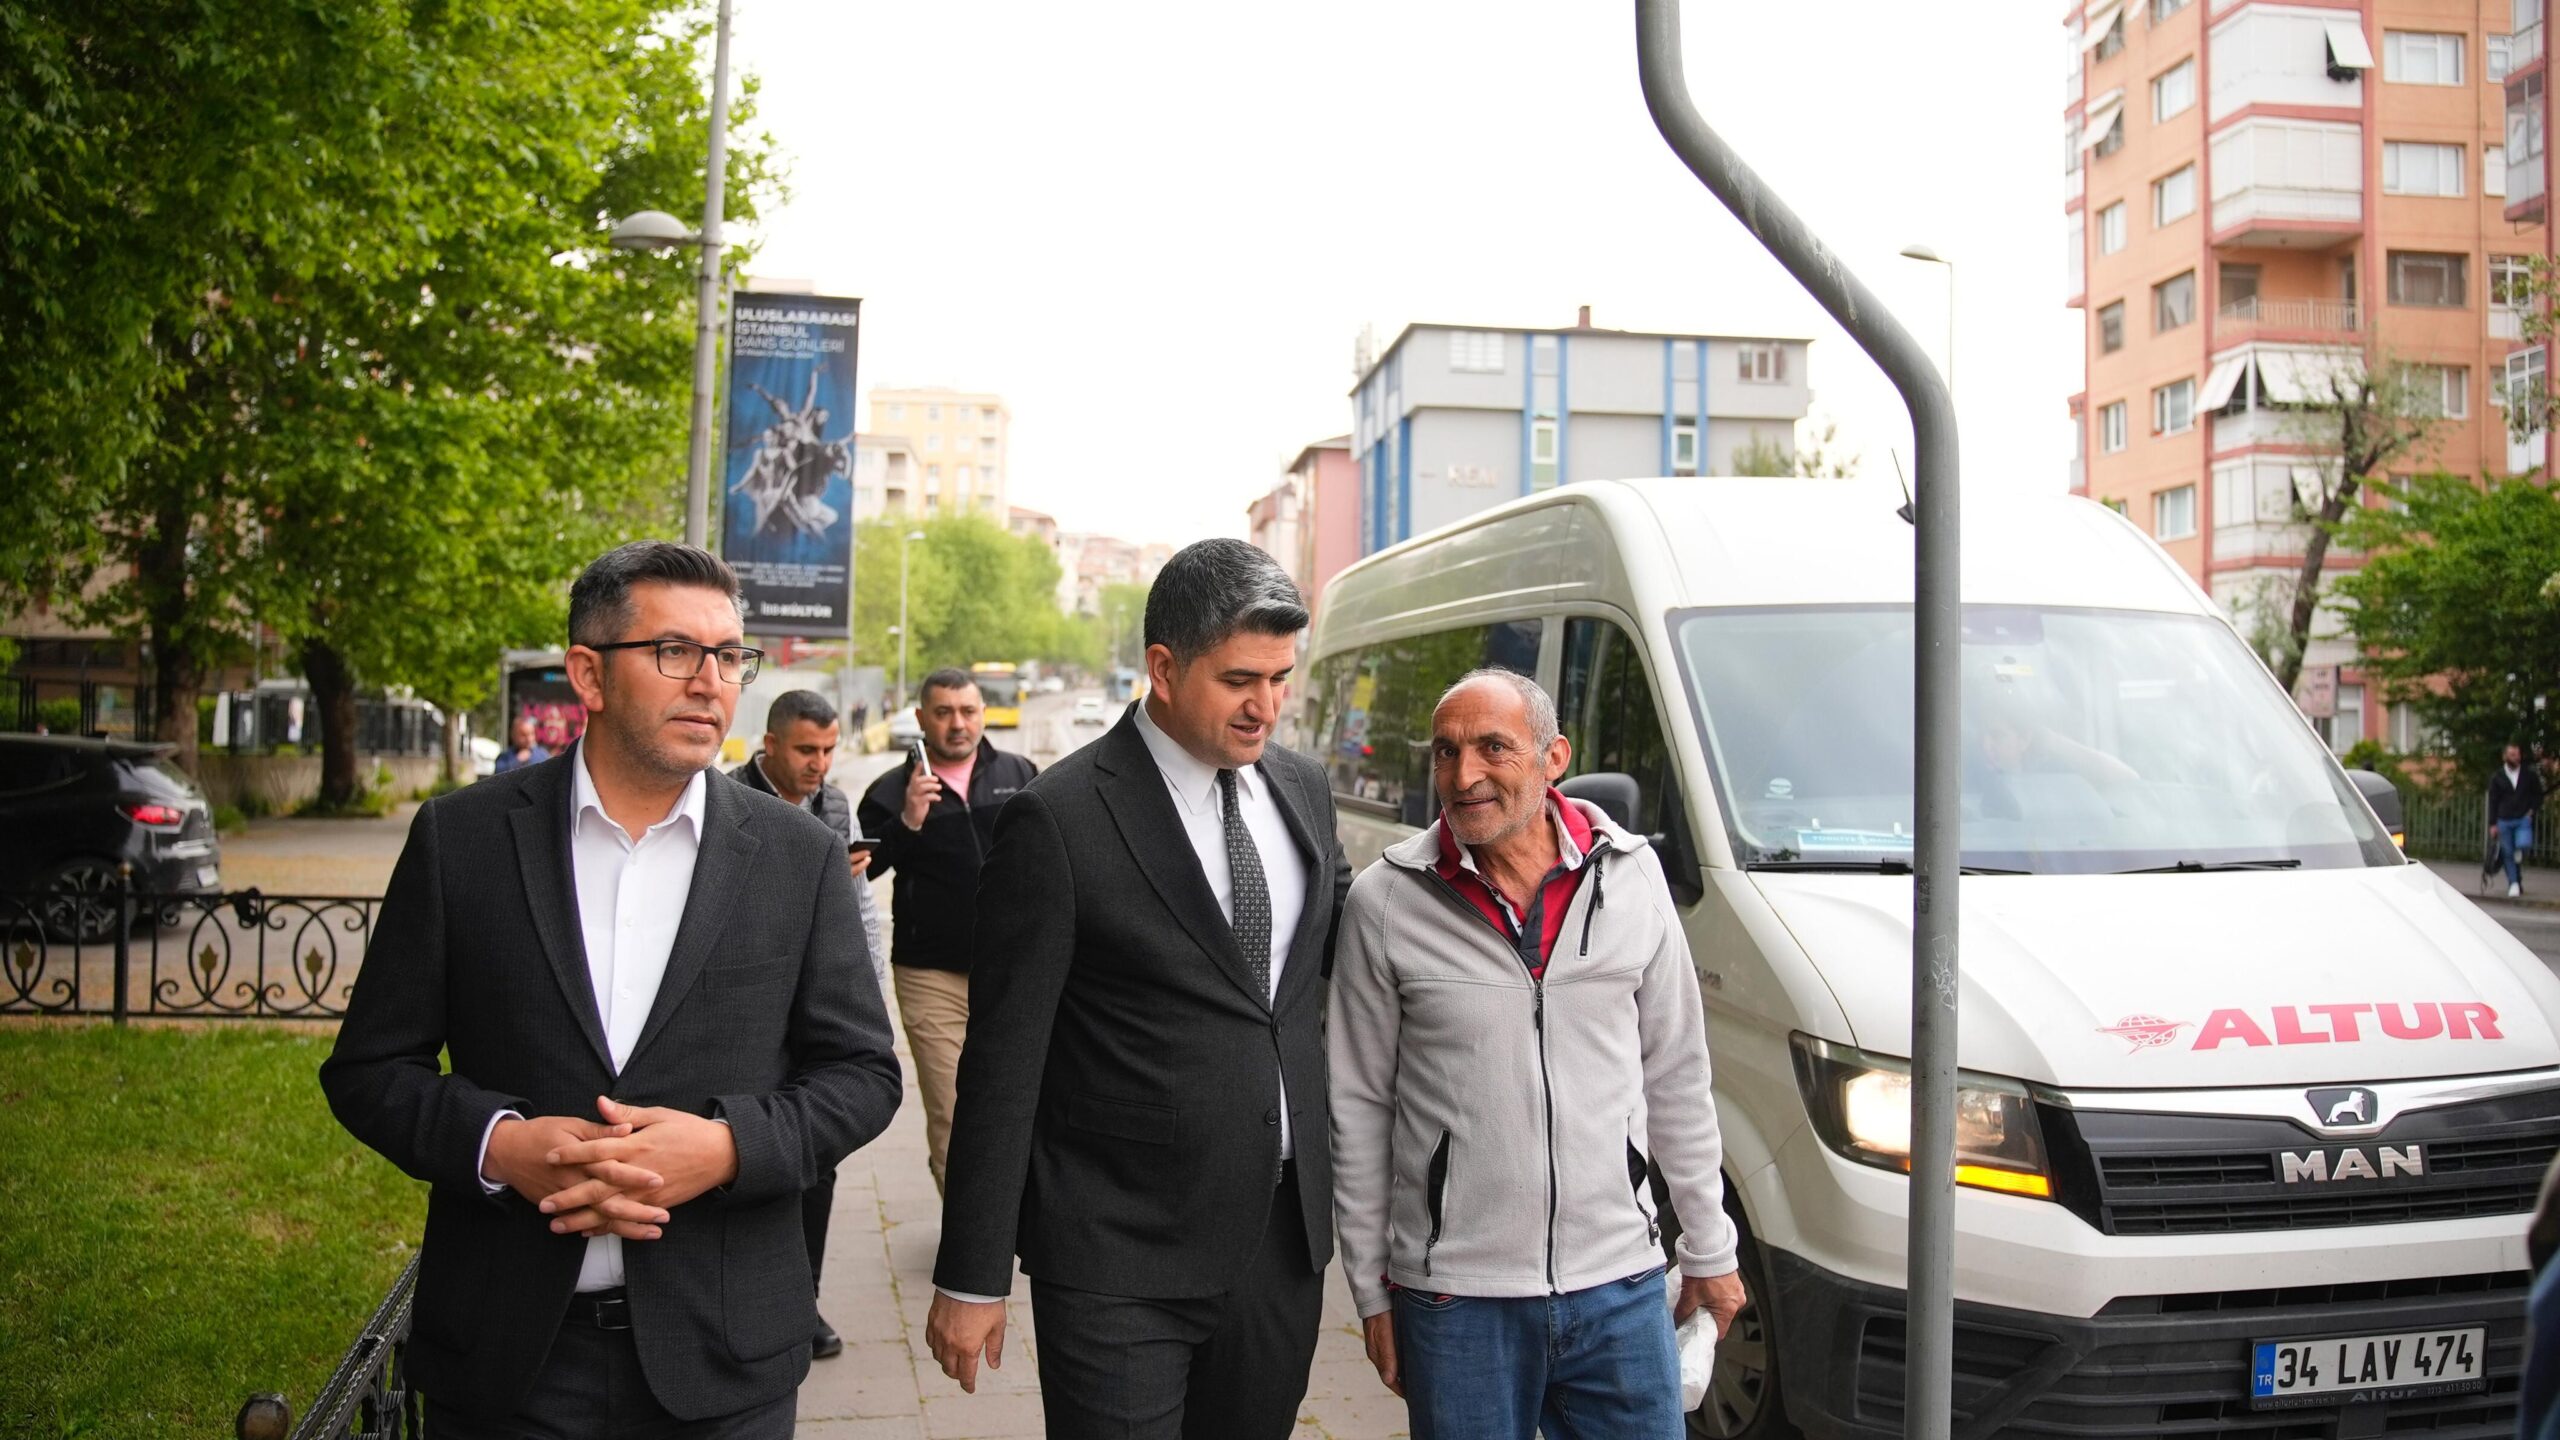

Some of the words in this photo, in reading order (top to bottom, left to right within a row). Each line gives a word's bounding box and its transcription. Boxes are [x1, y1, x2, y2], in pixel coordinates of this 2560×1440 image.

[735, 308, 857, 326] ULUSLARARASI
[734, 321, 810, 338] İSTANBUL
[734, 335, 777, 350] DANS
[2190, 1002, 2505, 1051] ALTUR
[2280, 1144, 2424, 1184] MAN
[2257, 1375, 2273, 1387] TR
[2278, 1346, 2319, 1388] 34
[2338, 1339, 2402, 1385] LAV
[2414, 1334, 2474, 1377] 474
[2350, 1389, 2417, 1402] Altur
